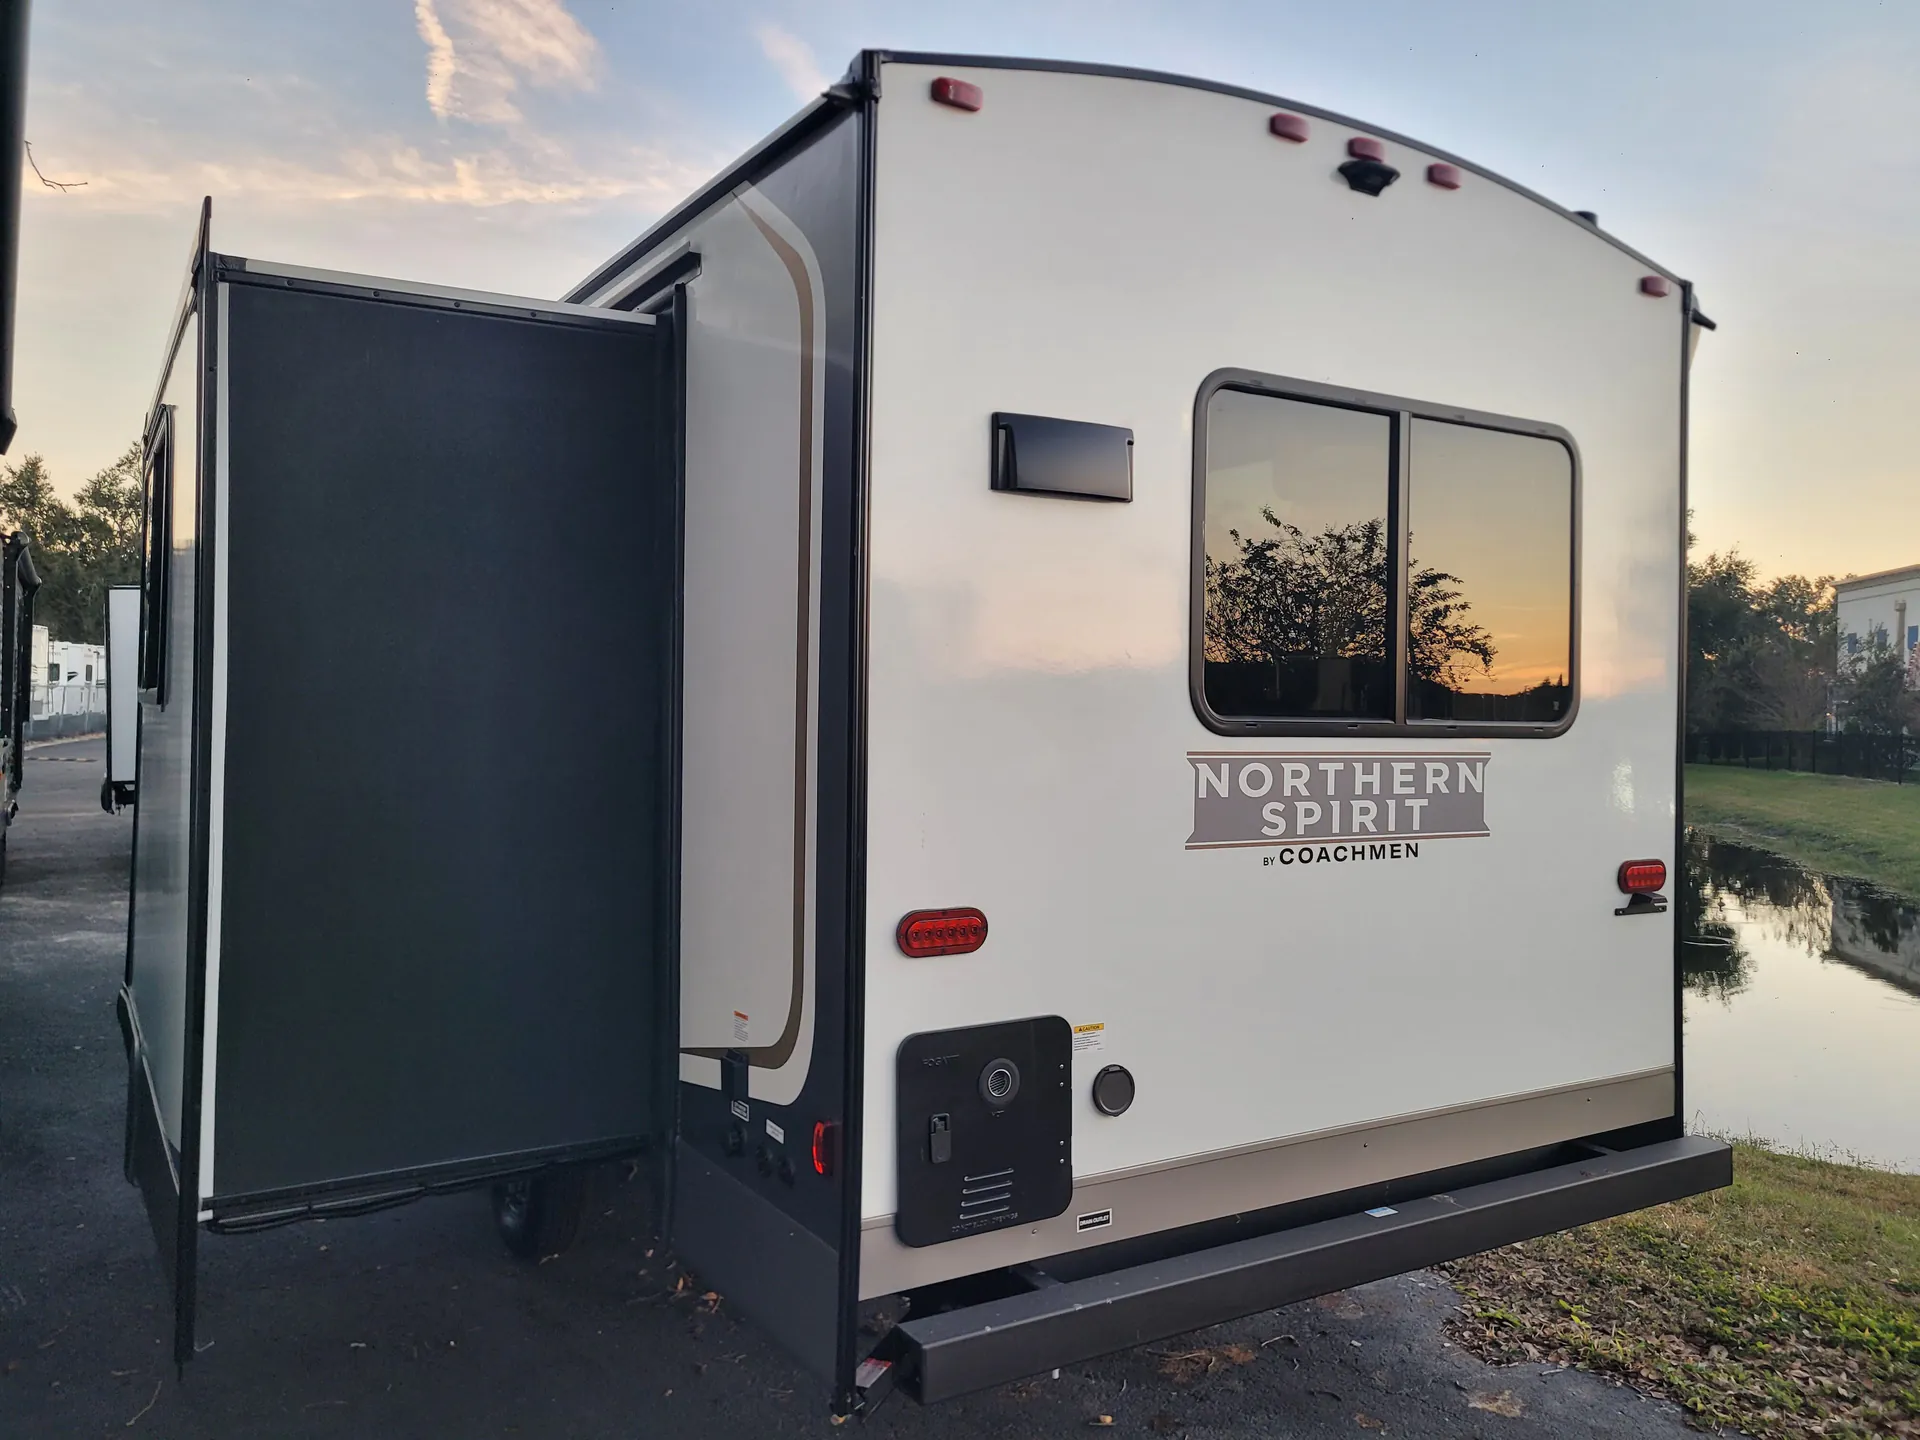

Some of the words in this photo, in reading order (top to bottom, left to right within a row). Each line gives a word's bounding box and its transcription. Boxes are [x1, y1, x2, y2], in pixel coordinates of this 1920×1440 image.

[1195, 762, 1483, 798] NORTHERN
[1260, 798, 1429, 837] SPIRIT
[1263, 856, 1275, 866] BY
[1279, 843, 1419, 865] COACHMEN
